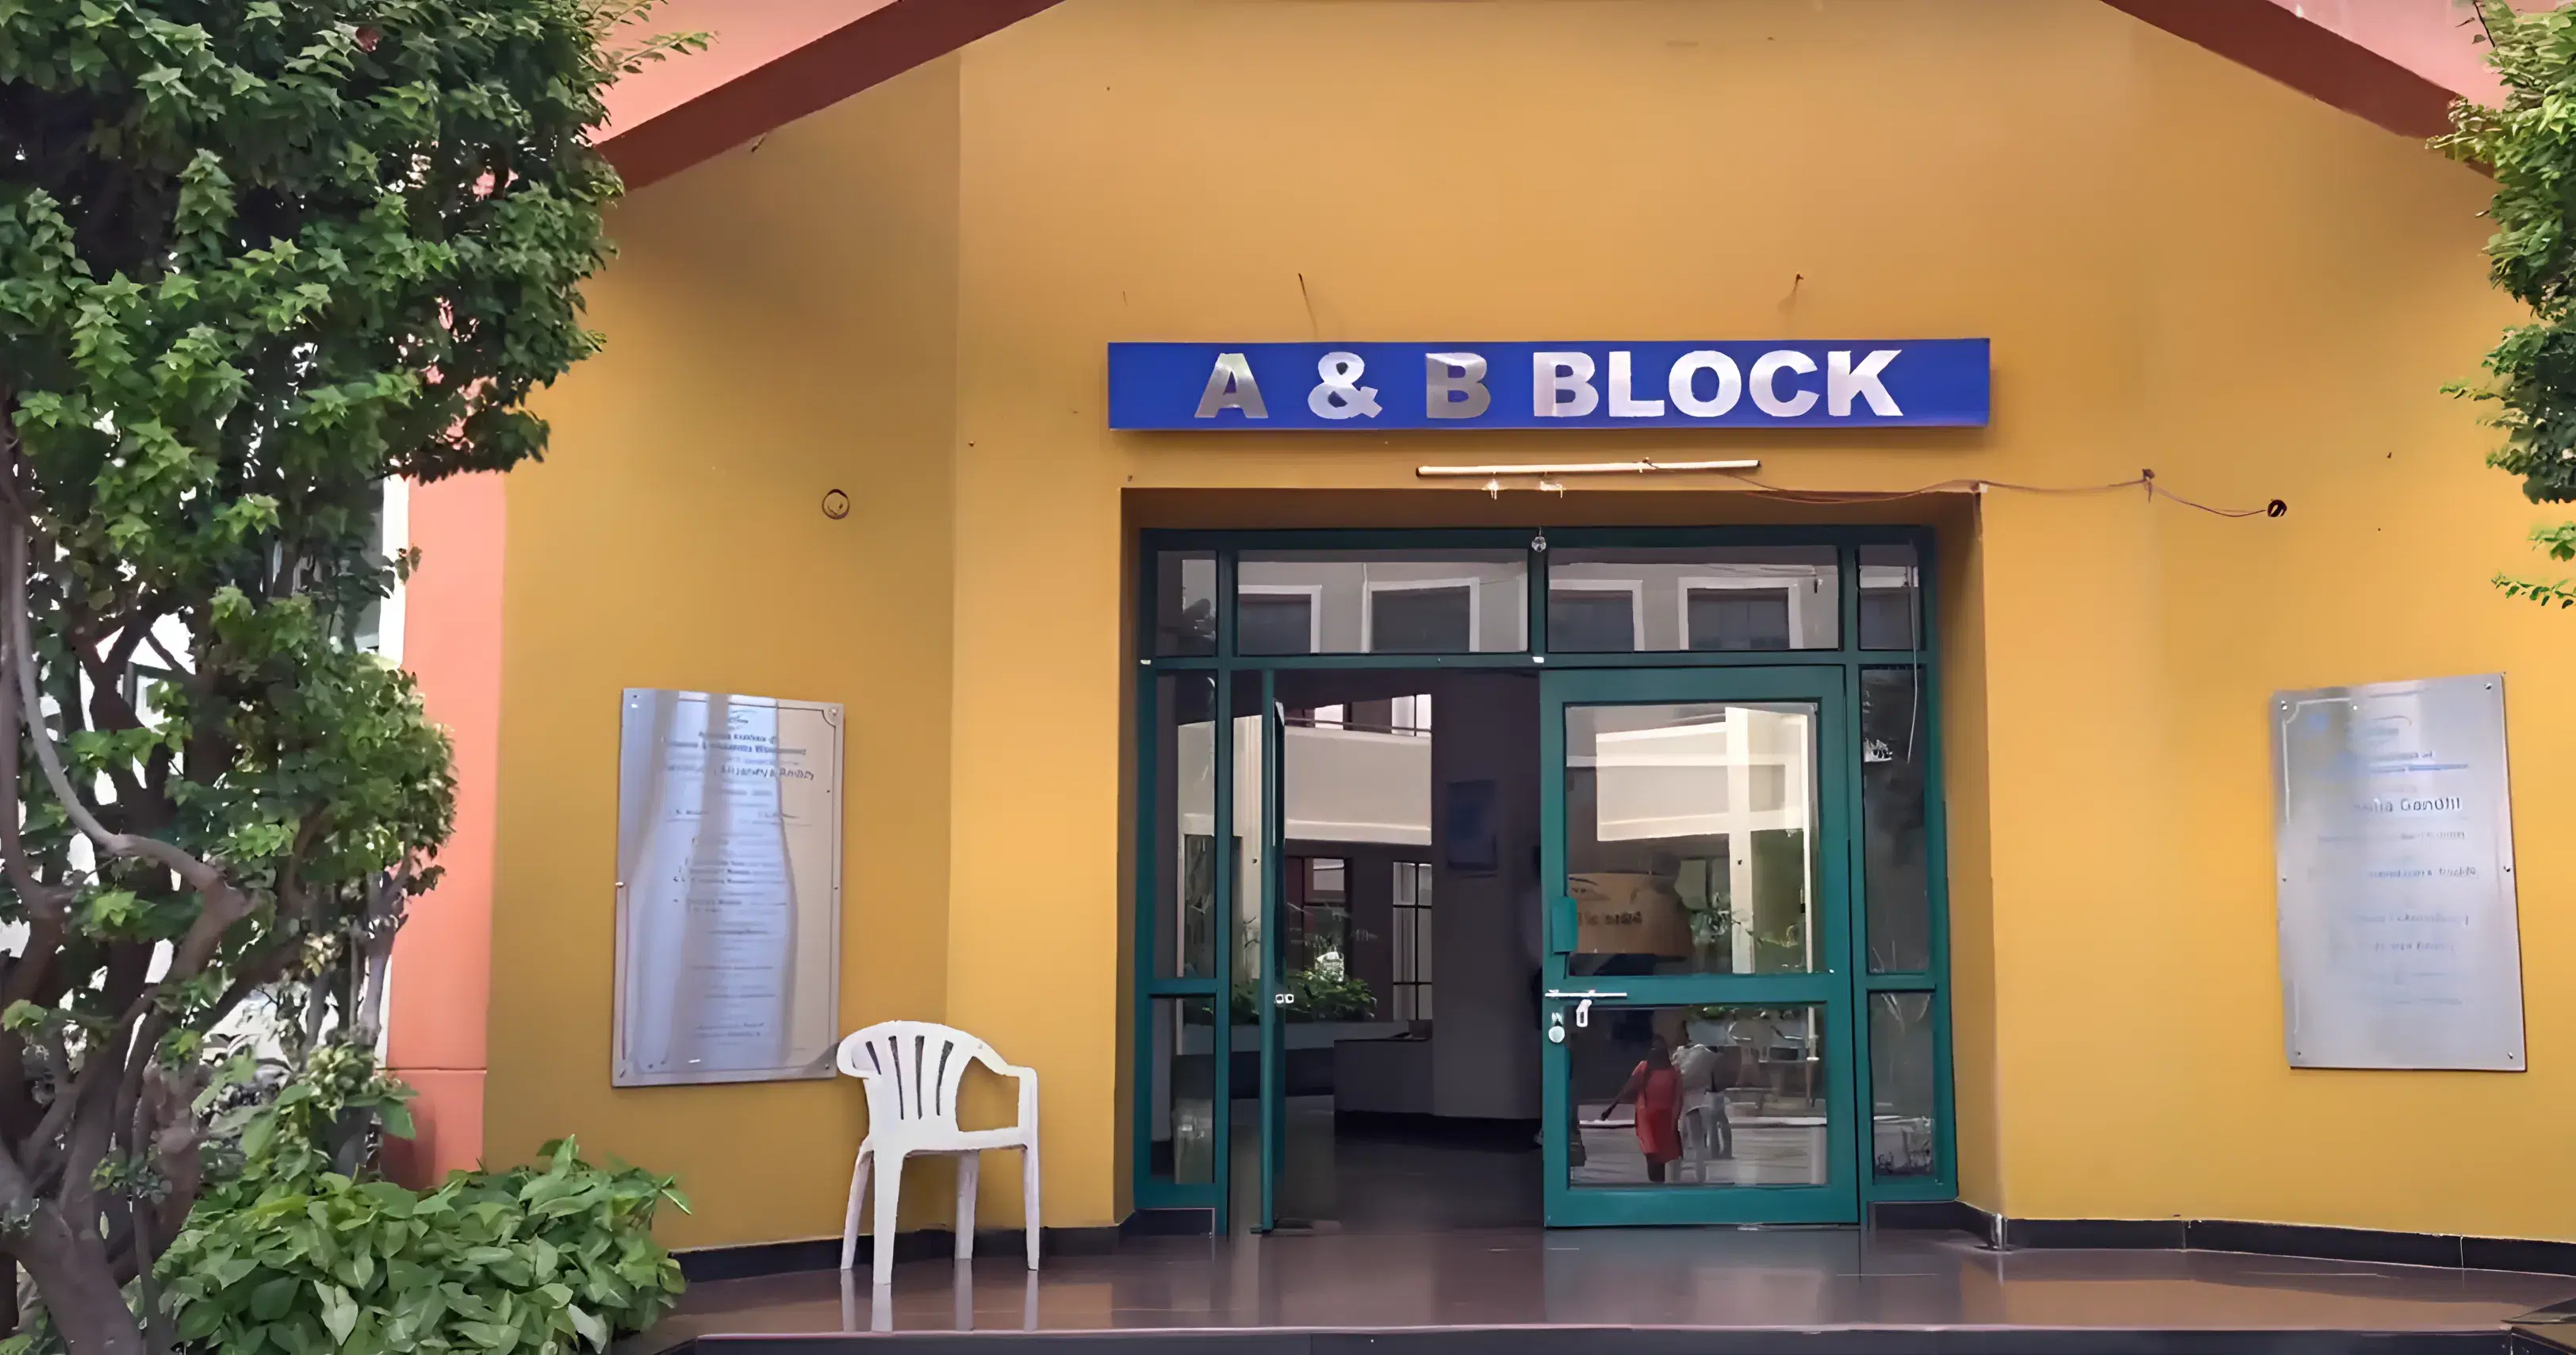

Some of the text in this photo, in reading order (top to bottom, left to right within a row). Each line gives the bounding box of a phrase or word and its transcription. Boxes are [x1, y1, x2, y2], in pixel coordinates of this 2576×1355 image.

[1194, 349, 1904, 420] A & B BLOCK
